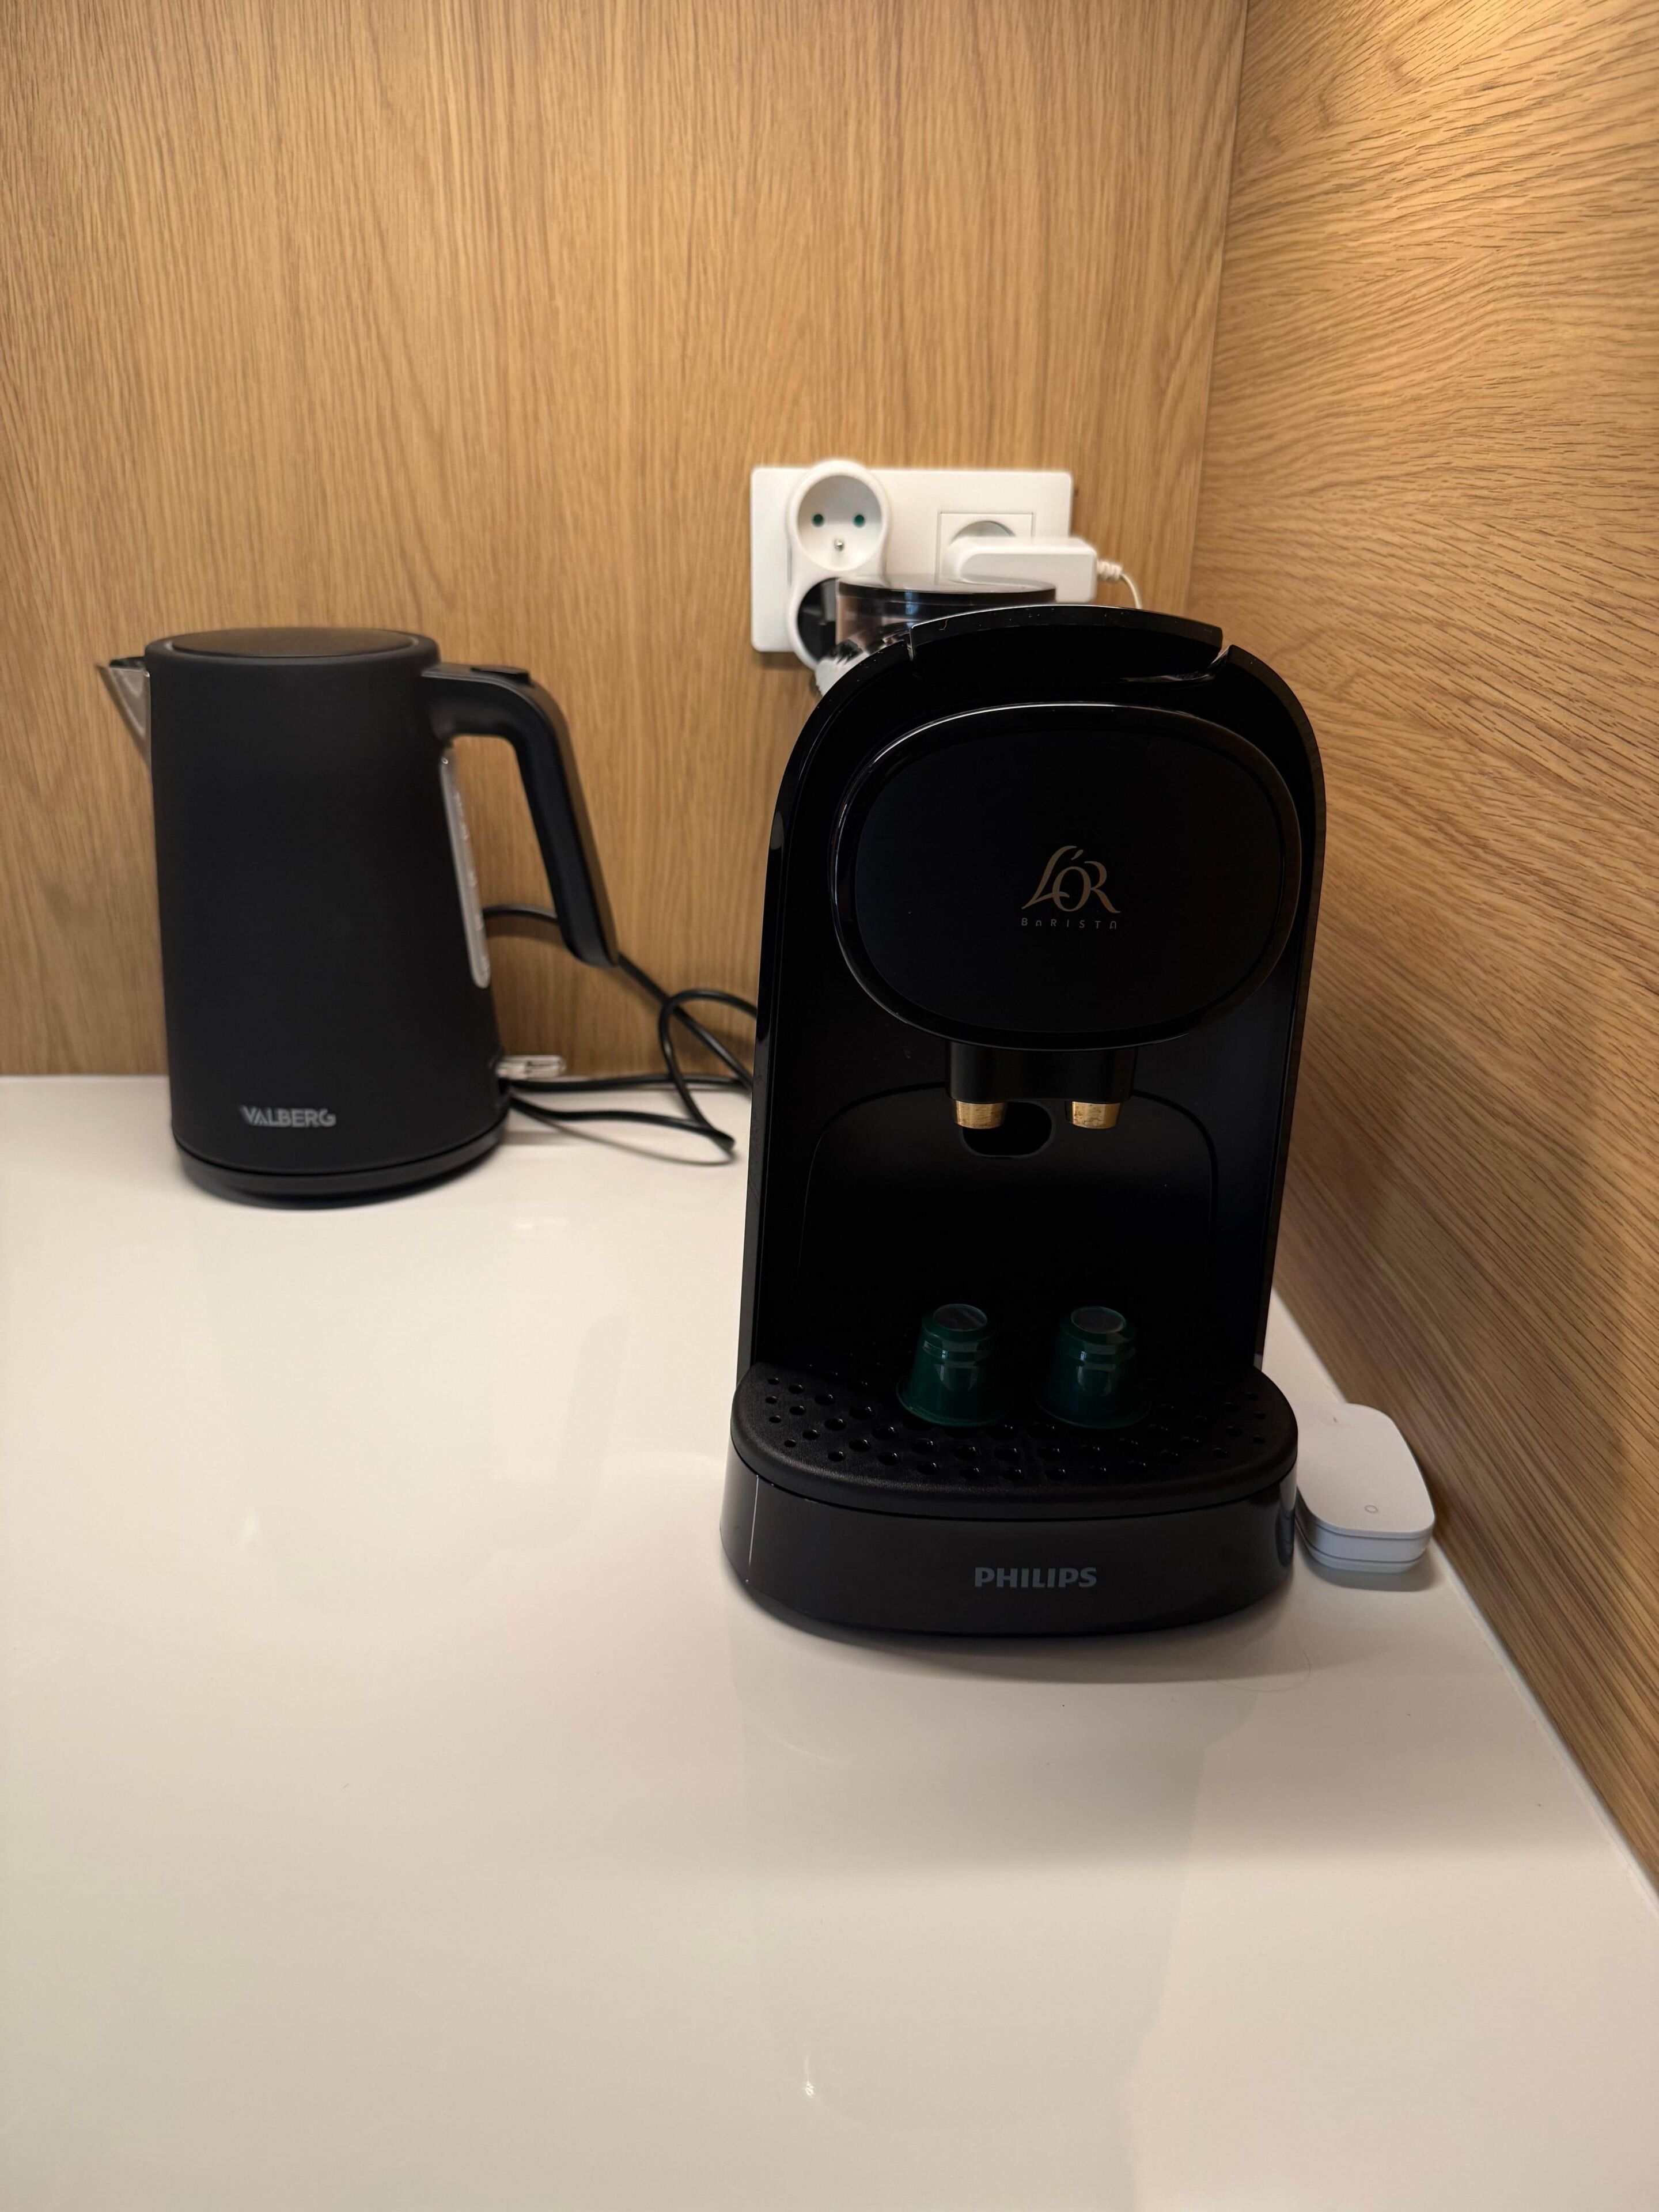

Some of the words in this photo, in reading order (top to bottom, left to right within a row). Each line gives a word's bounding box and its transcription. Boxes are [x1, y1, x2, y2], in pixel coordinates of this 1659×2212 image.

[1021, 845, 1122, 914] L'OR
[1021, 918, 1117, 930] BARISTA
[240, 1105, 337, 1127] VALBERG
[974, 1567, 1097, 1588] PHILIPS
